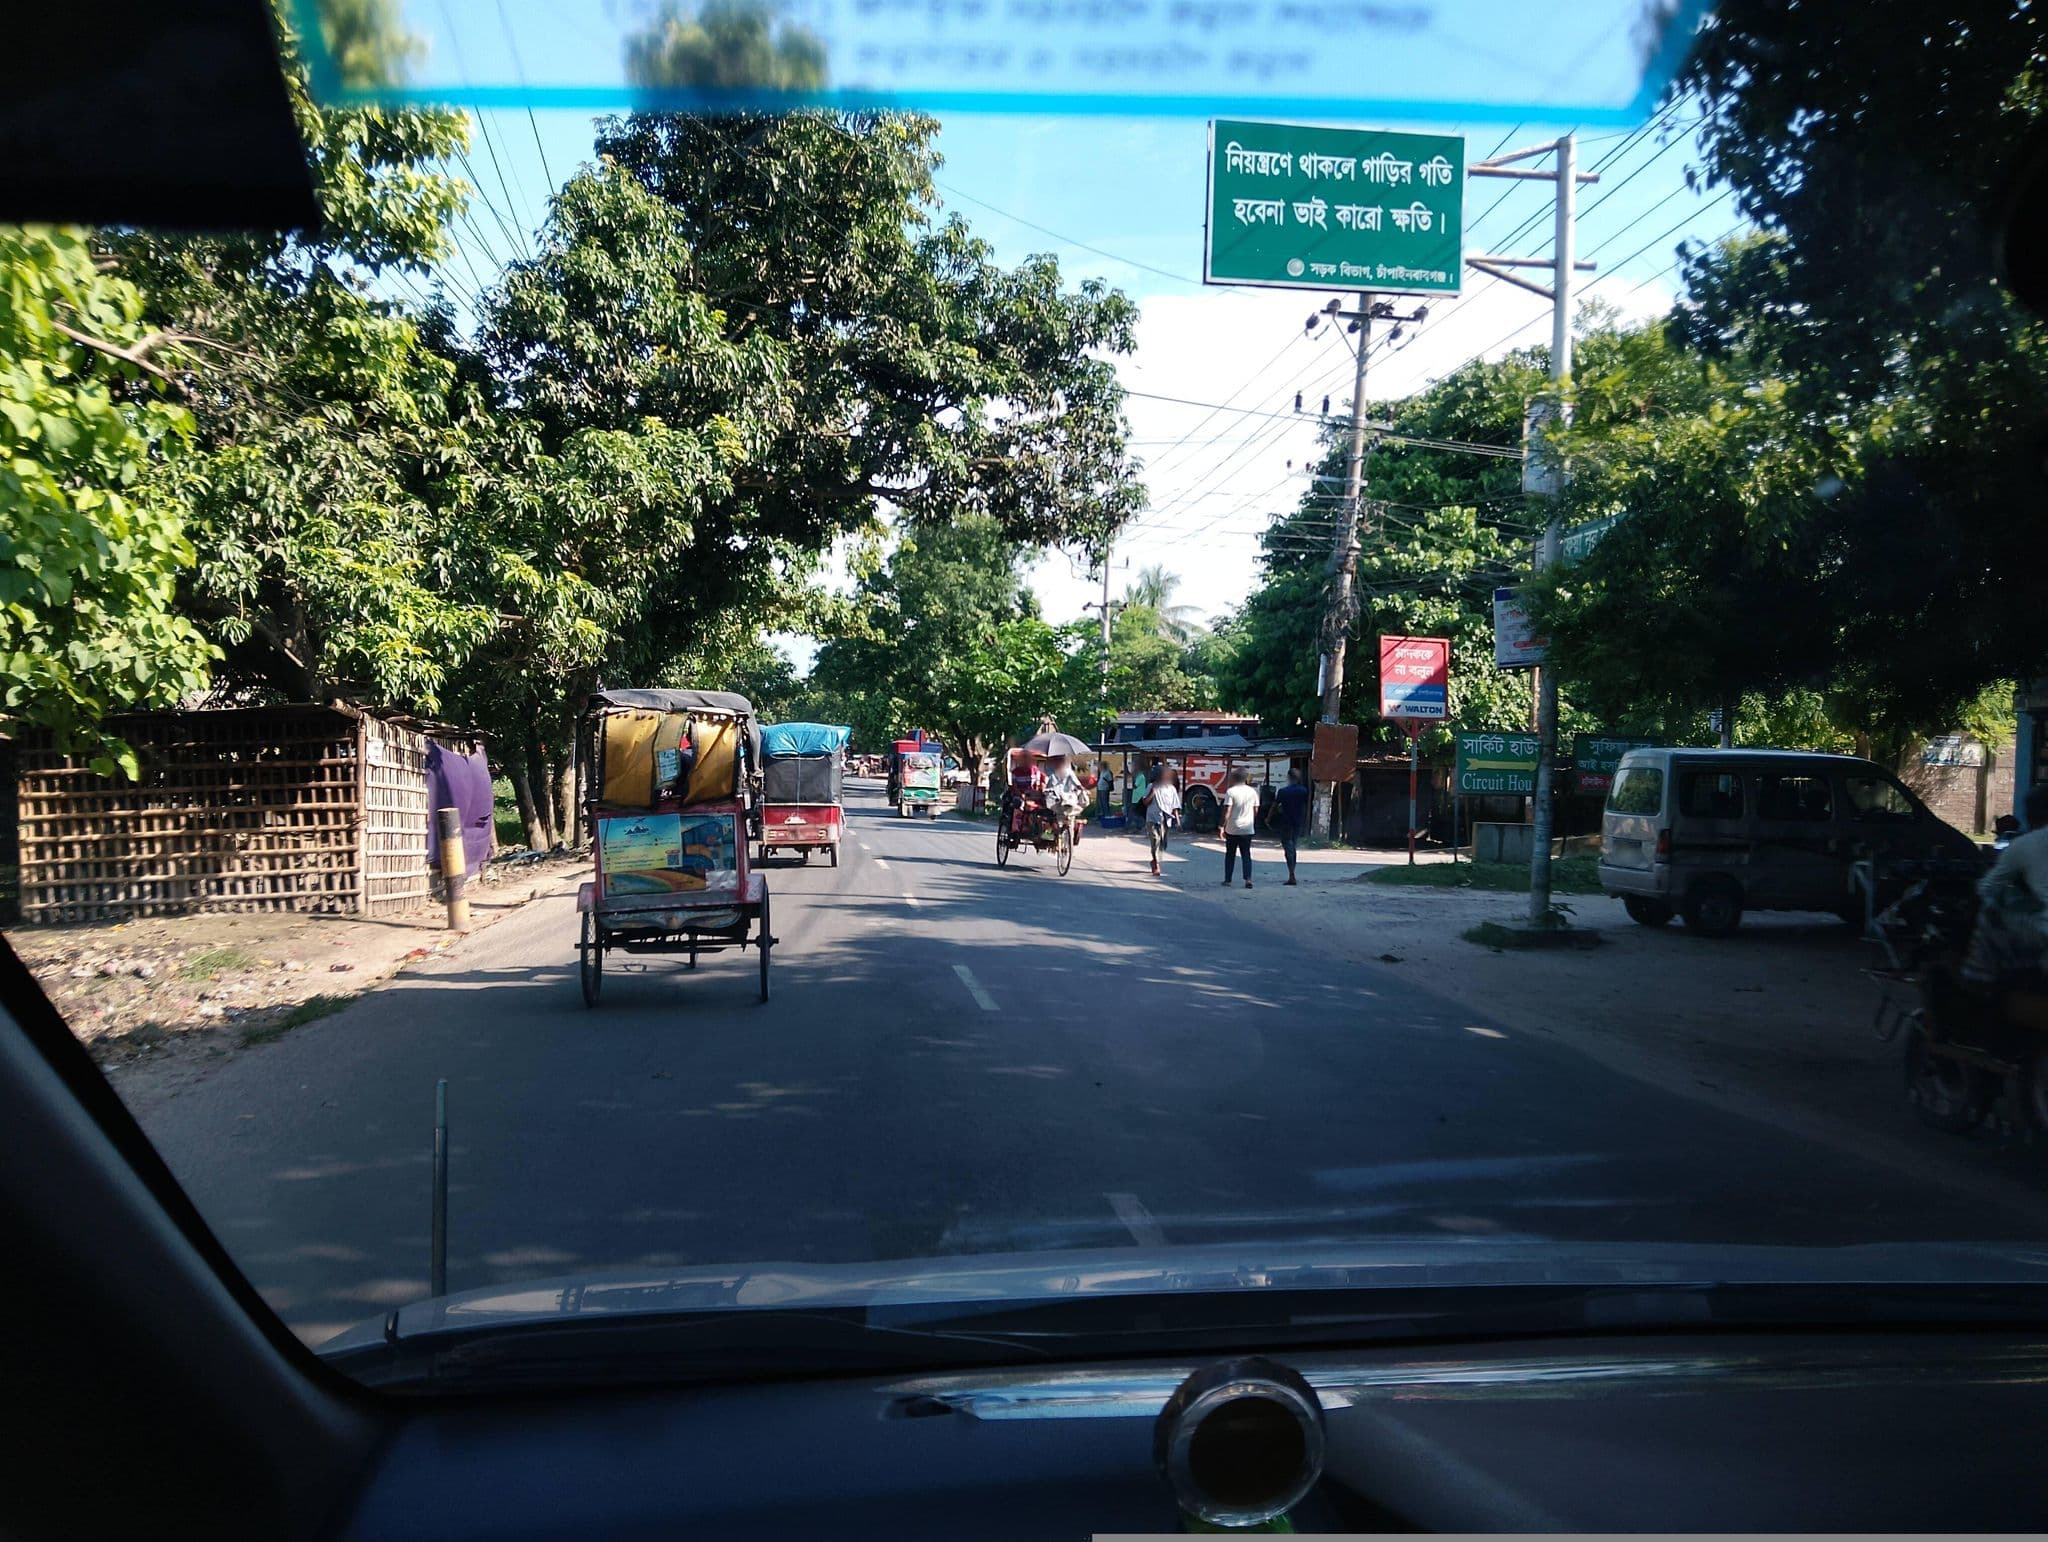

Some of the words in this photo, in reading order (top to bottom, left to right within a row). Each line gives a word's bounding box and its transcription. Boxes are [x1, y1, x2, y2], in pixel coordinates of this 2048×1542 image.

[1225, 141, 1293, 178] নিয়ন্ত্রণে
[1299, 151, 1356, 181] থাকলে
[1362, 152, 1412, 187] গাড়ির
[1419, 155, 1453, 186] গতি
[1232, 198, 1285, 226] হবেনা
[1293, 195, 1328, 231] ভাই
[1334, 204, 1383, 232] কারো
[1405, 704, 1443, 714] WALTON
[1462, 734, 1505, 755] সার্কিট
[1462, 772, 1504, 791] Circuit
